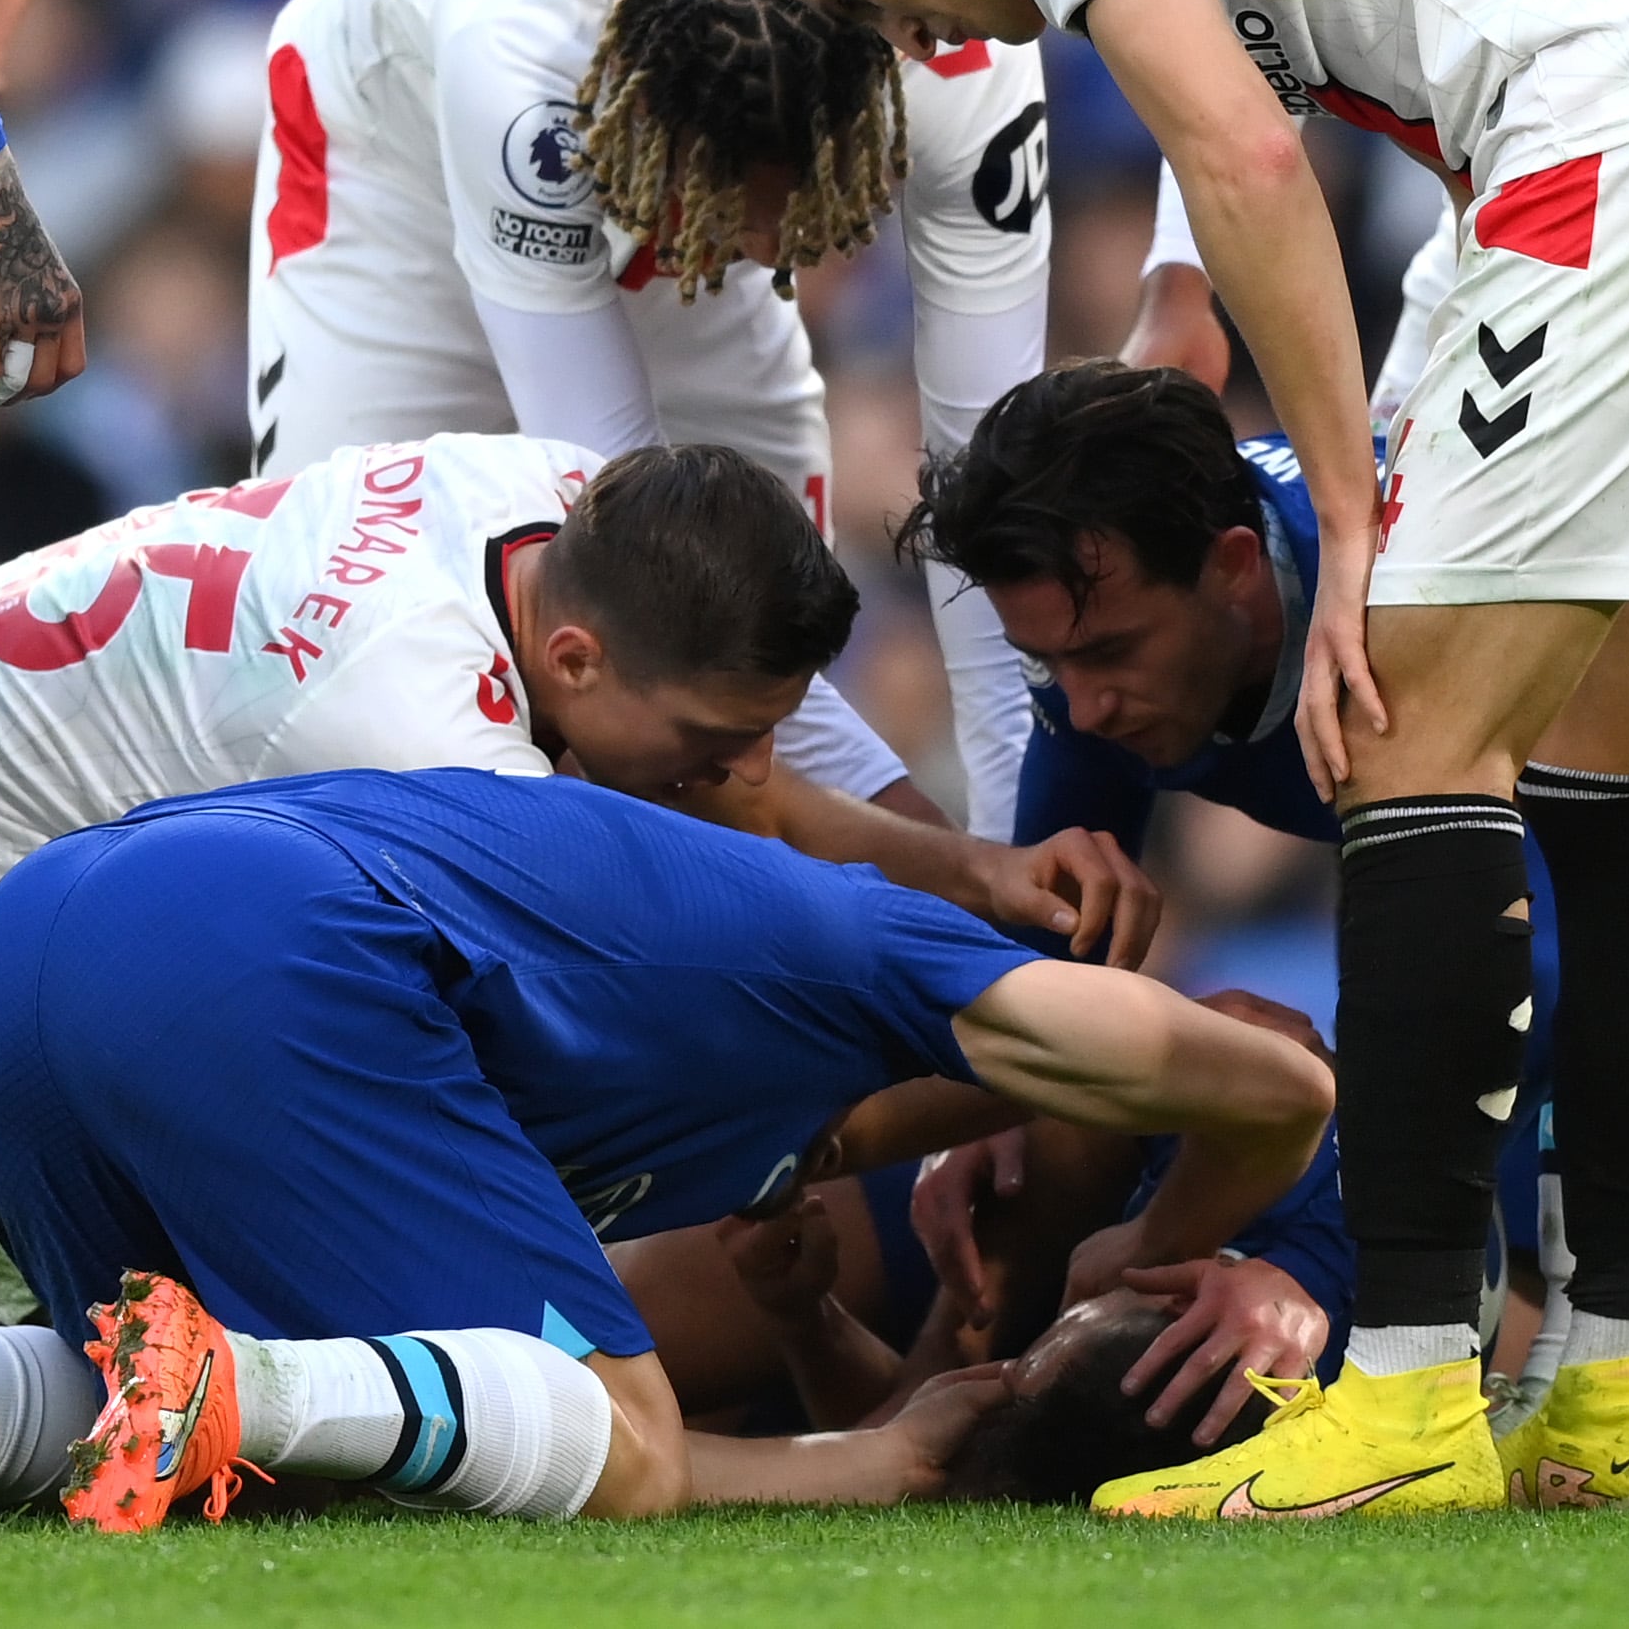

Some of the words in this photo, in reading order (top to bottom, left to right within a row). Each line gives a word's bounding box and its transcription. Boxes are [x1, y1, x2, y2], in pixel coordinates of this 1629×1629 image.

[993, 117, 1049, 222] JD
[492, 210, 524, 236] No
[525, 221, 585, 249] room
[261, 443, 426, 685] DNAREK
